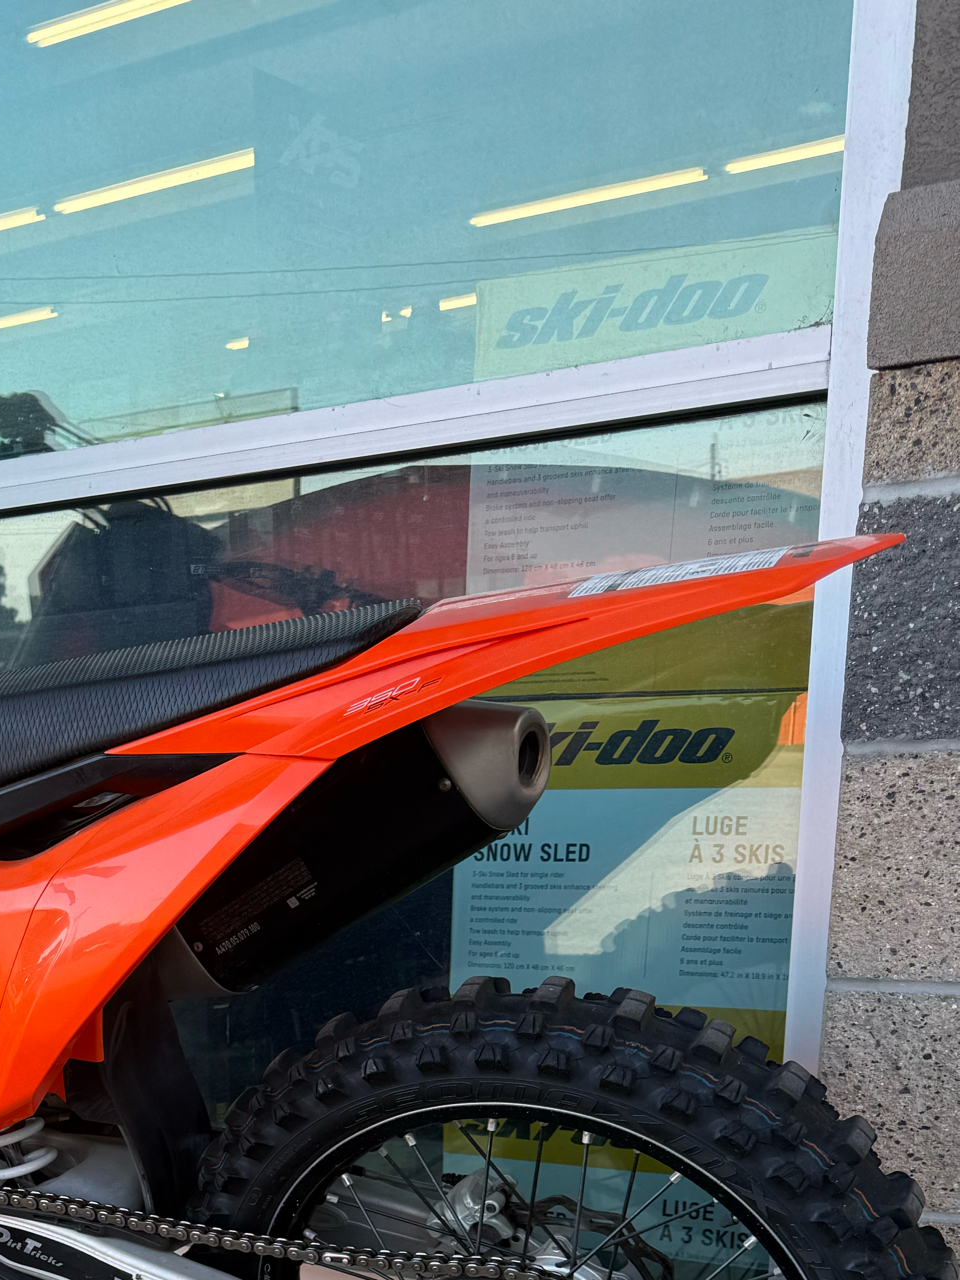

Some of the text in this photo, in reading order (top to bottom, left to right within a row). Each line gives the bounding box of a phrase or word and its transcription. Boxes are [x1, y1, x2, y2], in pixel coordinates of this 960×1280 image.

[495, 273, 769, 350] ski-doo
[486, 474, 522, 486] Handlebars
[523, 474, 536, 483] and
[537, 473, 542, 482] 3
[542, 471, 569, 483] grooved
[570, 470, 584, 478] skis
[486, 490, 499, 499] and
[485, 492, 617, 512] Brake system and non-slipping seat offer
[490, 513, 536, 525] controlled ride
[710, 510, 731, 519] Corde
[731, 509, 749, 519] pour
[484, 521, 589, 538] Tow leash to help transport uphill
[708, 520, 774, 533] Assemblage facile
[484, 539, 530, 552] Easy Assembly
[707, 535, 754, 546] 6 ans et plus
[483, 552, 538, 564] For ages and up
[559, 562, 569, 571] cm
[585, 560, 596, 568] cm
[343, 676, 422, 717] 350
[363, 676, 442, 715] SX-F
[546, 719, 736, 767] ki-doo
[692, 815, 749, 836] LUGE
[473, 842, 591, 863] SNOW SLED
[688, 838, 786, 865] À 3 SKIS
[472, 870, 488, 878] 3-Ski
[489, 870, 505, 878] Snow
[506, 870, 519, 878] Sled
[530, 871, 549, 880] single
[550, 871, 565, 879] rider
[717, 873, 731, 881] Skis
[760, 875, 777, 883] pour
[471, 882, 591, 892] Handlebars and 3 grooved skis enhance
[725, 886, 740, 894] skis
[740, 886, 770, 894] rainurés
[770, 887, 788, 895] pour
[470, 893, 531, 902] and maneuverability
[684, 897, 693, 905] et
[470, 905, 487, 913] Brake
[488, 905, 510, 914] system
[523, 906, 562, 915] non-slipping
[683, 909, 712, 918] Système
[724, 910, 753, 919] freinage
[763, 911, 782, 920] siège
[474, 916, 505, 924] controlled
[682, 922, 715, 930] descente
[469, 927, 481, 935] Tow
[481, 928, 498, 936] leash
[506, 928, 520, 937] help
[521, 929, 550, 937] transport
[468, 939, 512, 948] Easy Assembly
[681, 933, 701, 942] Corde
[702, 934, 719, 943] pour
[719, 934, 746, 943] faciliter
[755, 936, 788, 945] transport
[468, 950, 478, 958] For
[478, 951, 493, 959] ages
[511, 952, 520, 960] up
[680, 945, 742, 955] Assemblage facile
[503, 962, 515, 970] 120
[685, 958, 724, 967] ans et plus
[678, 969, 719, 978] Dimensions:
[720, 970, 735, 979] 47.2
[736, 971, 744, 979] in
[751, 972, 767, 980] 18.9
[662, 1198, 715, 1222] LUGE
[681, 1226, 693, 1244] 3
[701, 1228, 751, 1250] SKIS
[22, 1237, 65, 1268] Tricks
